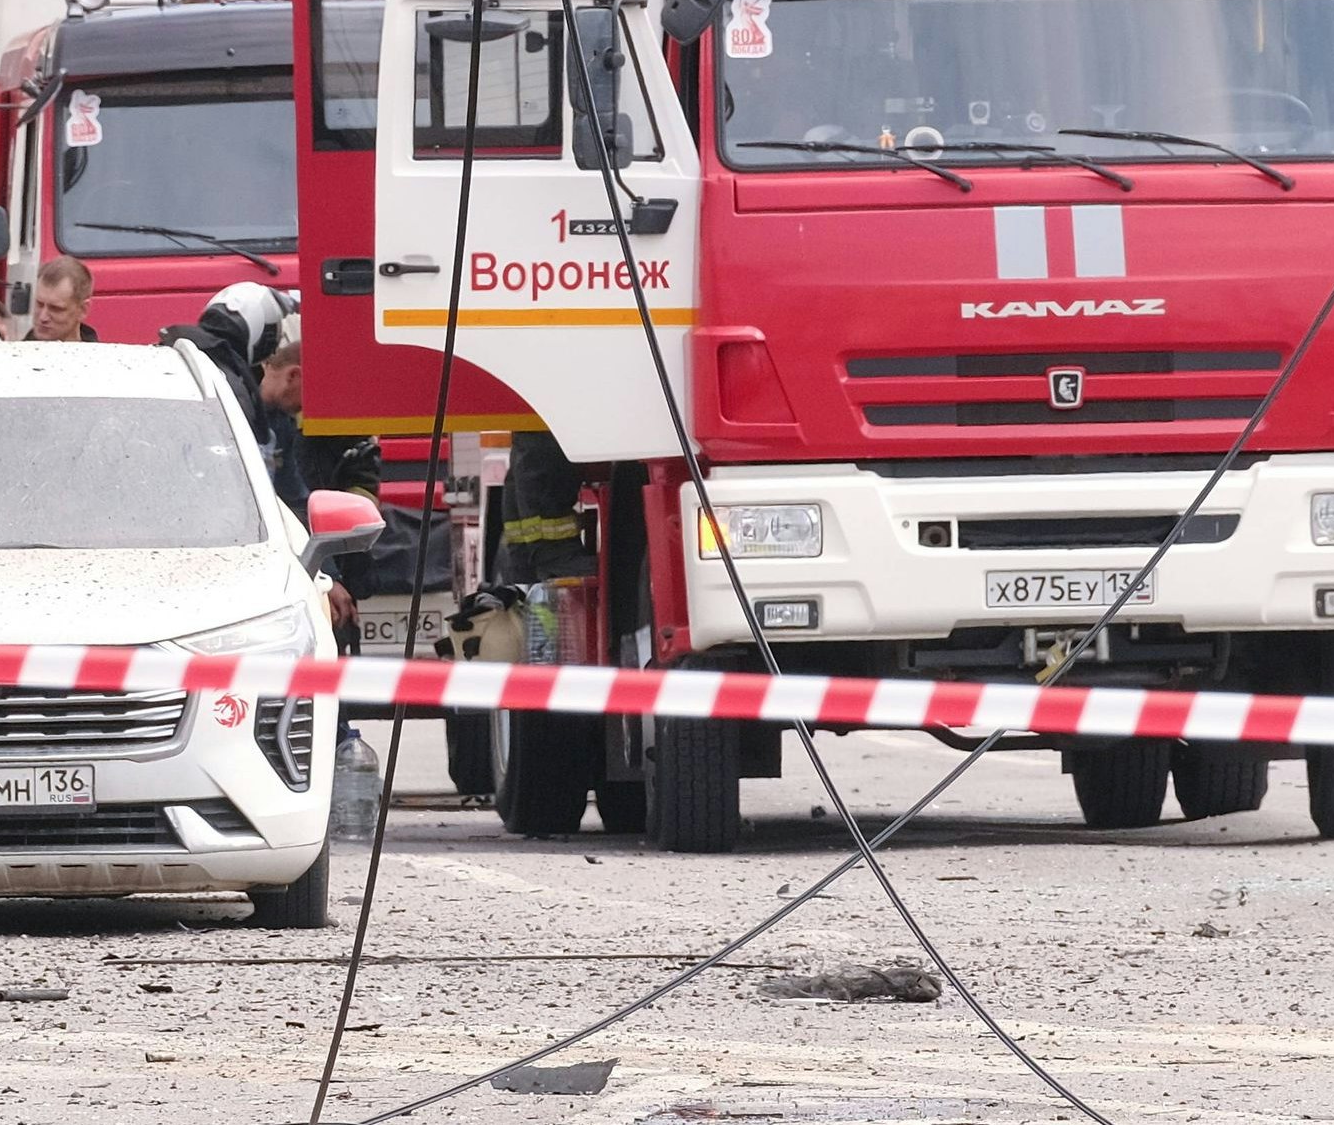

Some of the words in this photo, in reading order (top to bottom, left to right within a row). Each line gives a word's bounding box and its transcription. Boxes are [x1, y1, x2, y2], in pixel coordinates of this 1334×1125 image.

[731, 28, 750, 45] 80
[551, 208, 566, 243] 1
[471, 252, 670, 302] Воронеж
[961, 298, 1165, 318] KAMAZ
[40, 769, 85, 793] 136
[49, 793, 72, 803] RUS
